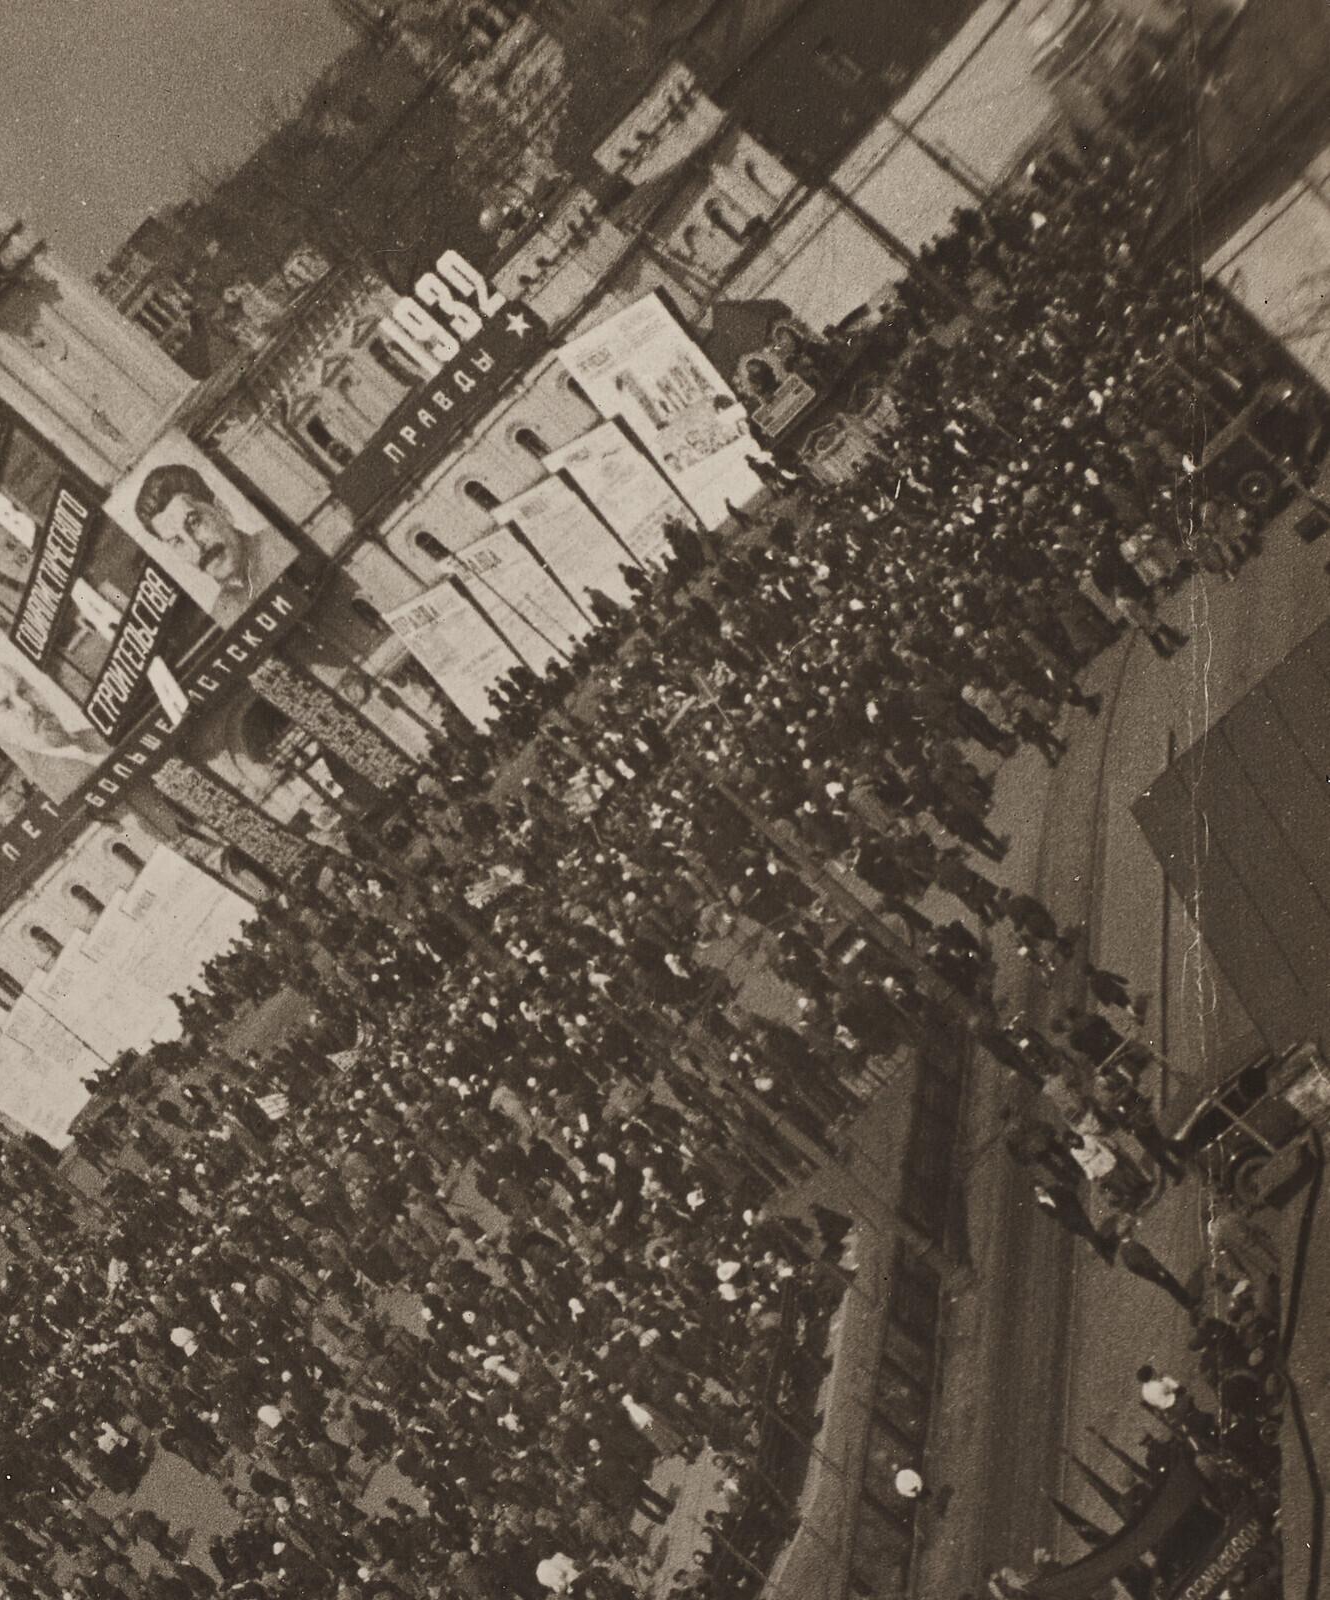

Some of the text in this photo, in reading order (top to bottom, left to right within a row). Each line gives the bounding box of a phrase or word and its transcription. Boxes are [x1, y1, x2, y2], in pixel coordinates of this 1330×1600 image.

[379, 248, 505, 380] 1932
[3, 803, 58, 860] ЛЕТ
[382, 350, 496, 466] ПРАВДЫ
[15, 489, 88, 660] СОЦИАЛИСТИЧЕСКОГО
[86, 566, 175, 736] СТРОИТЕЛЬСТВА
